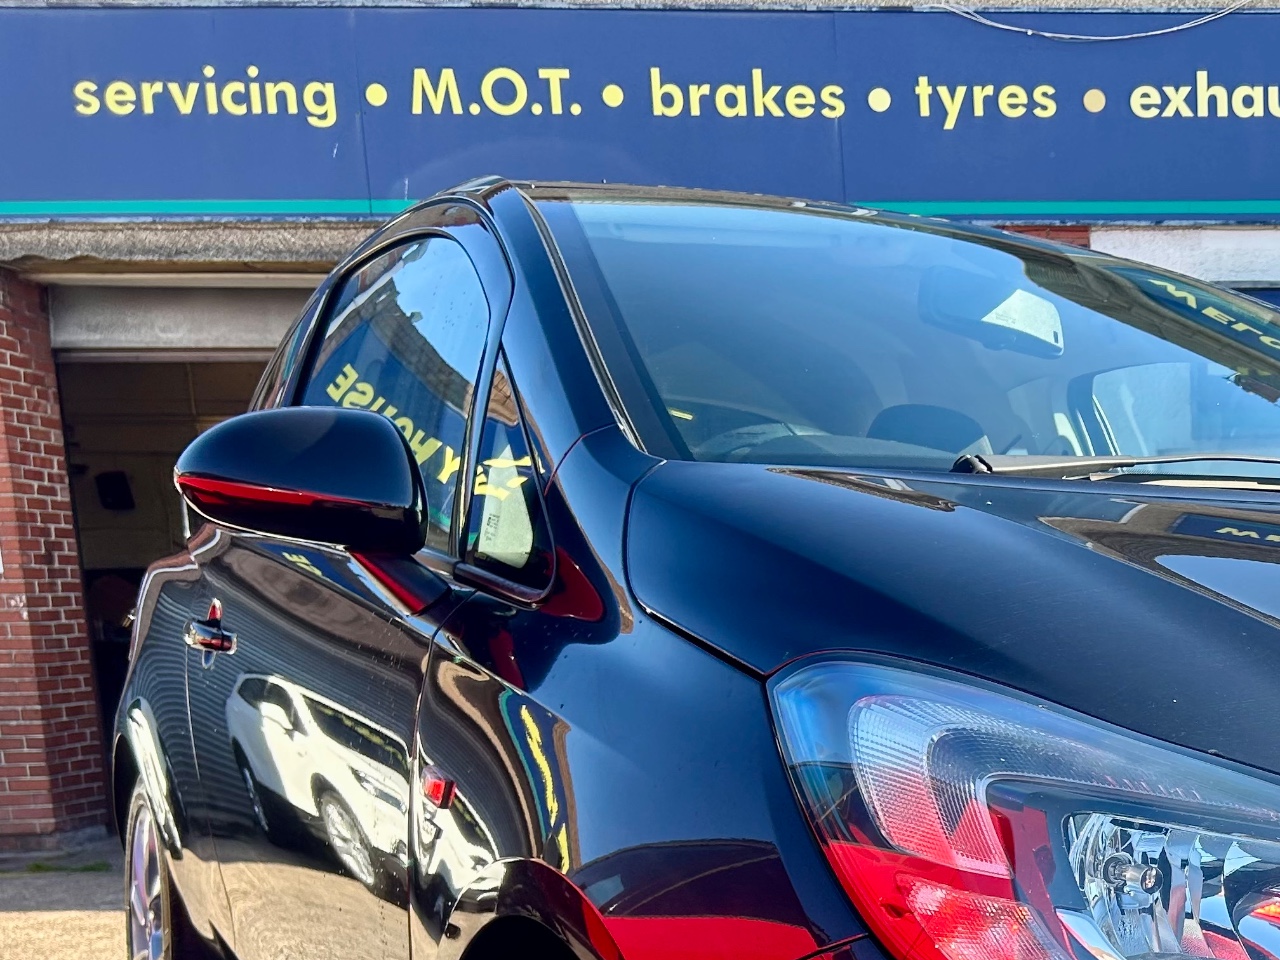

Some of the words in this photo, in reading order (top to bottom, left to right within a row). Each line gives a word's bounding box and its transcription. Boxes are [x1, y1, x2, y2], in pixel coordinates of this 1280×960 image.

[74, 66, 337, 127] servicing
[412, 68, 581, 115] M.O.T.
[651, 68, 845, 117] brakes
[916, 77, 1056, 129] tyres
